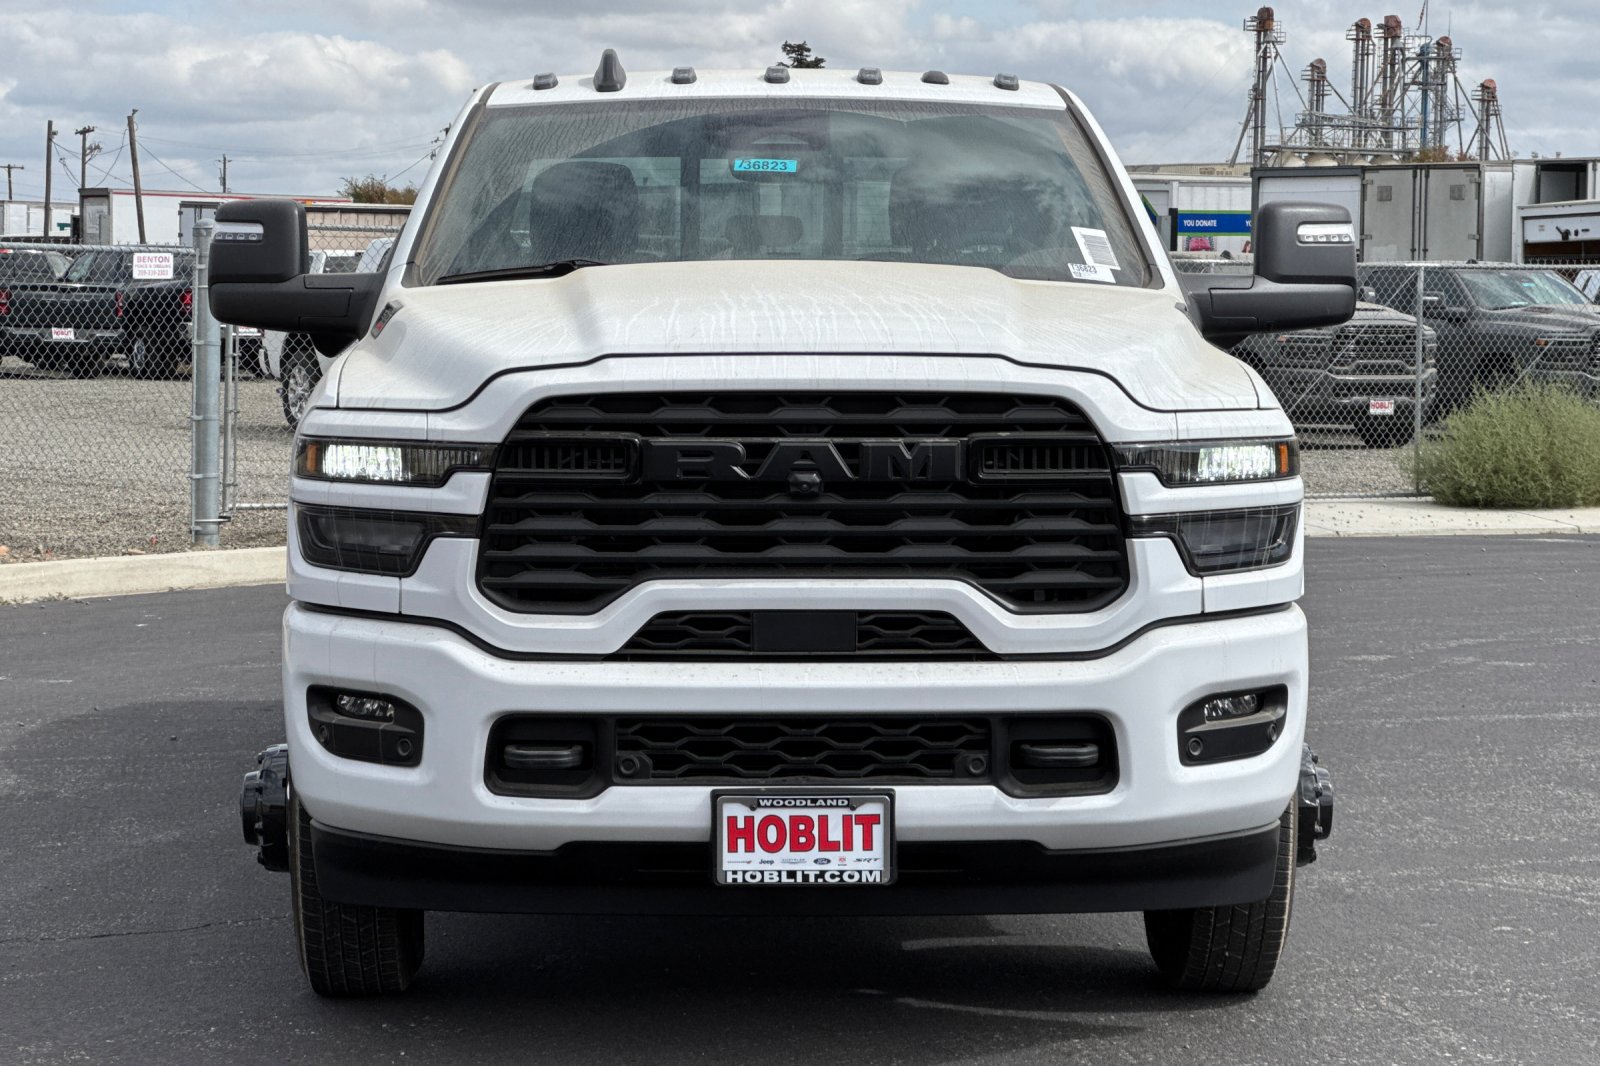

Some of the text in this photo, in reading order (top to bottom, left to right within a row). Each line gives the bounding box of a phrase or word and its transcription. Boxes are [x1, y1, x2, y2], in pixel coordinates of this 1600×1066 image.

[647, 438, 962, 482] RAM
[759, 799, 849, 807] WOODLAND
[727, 814, 881, 854] HOBLIT
[726, 871, 882, 883] HOBLIT.COM
